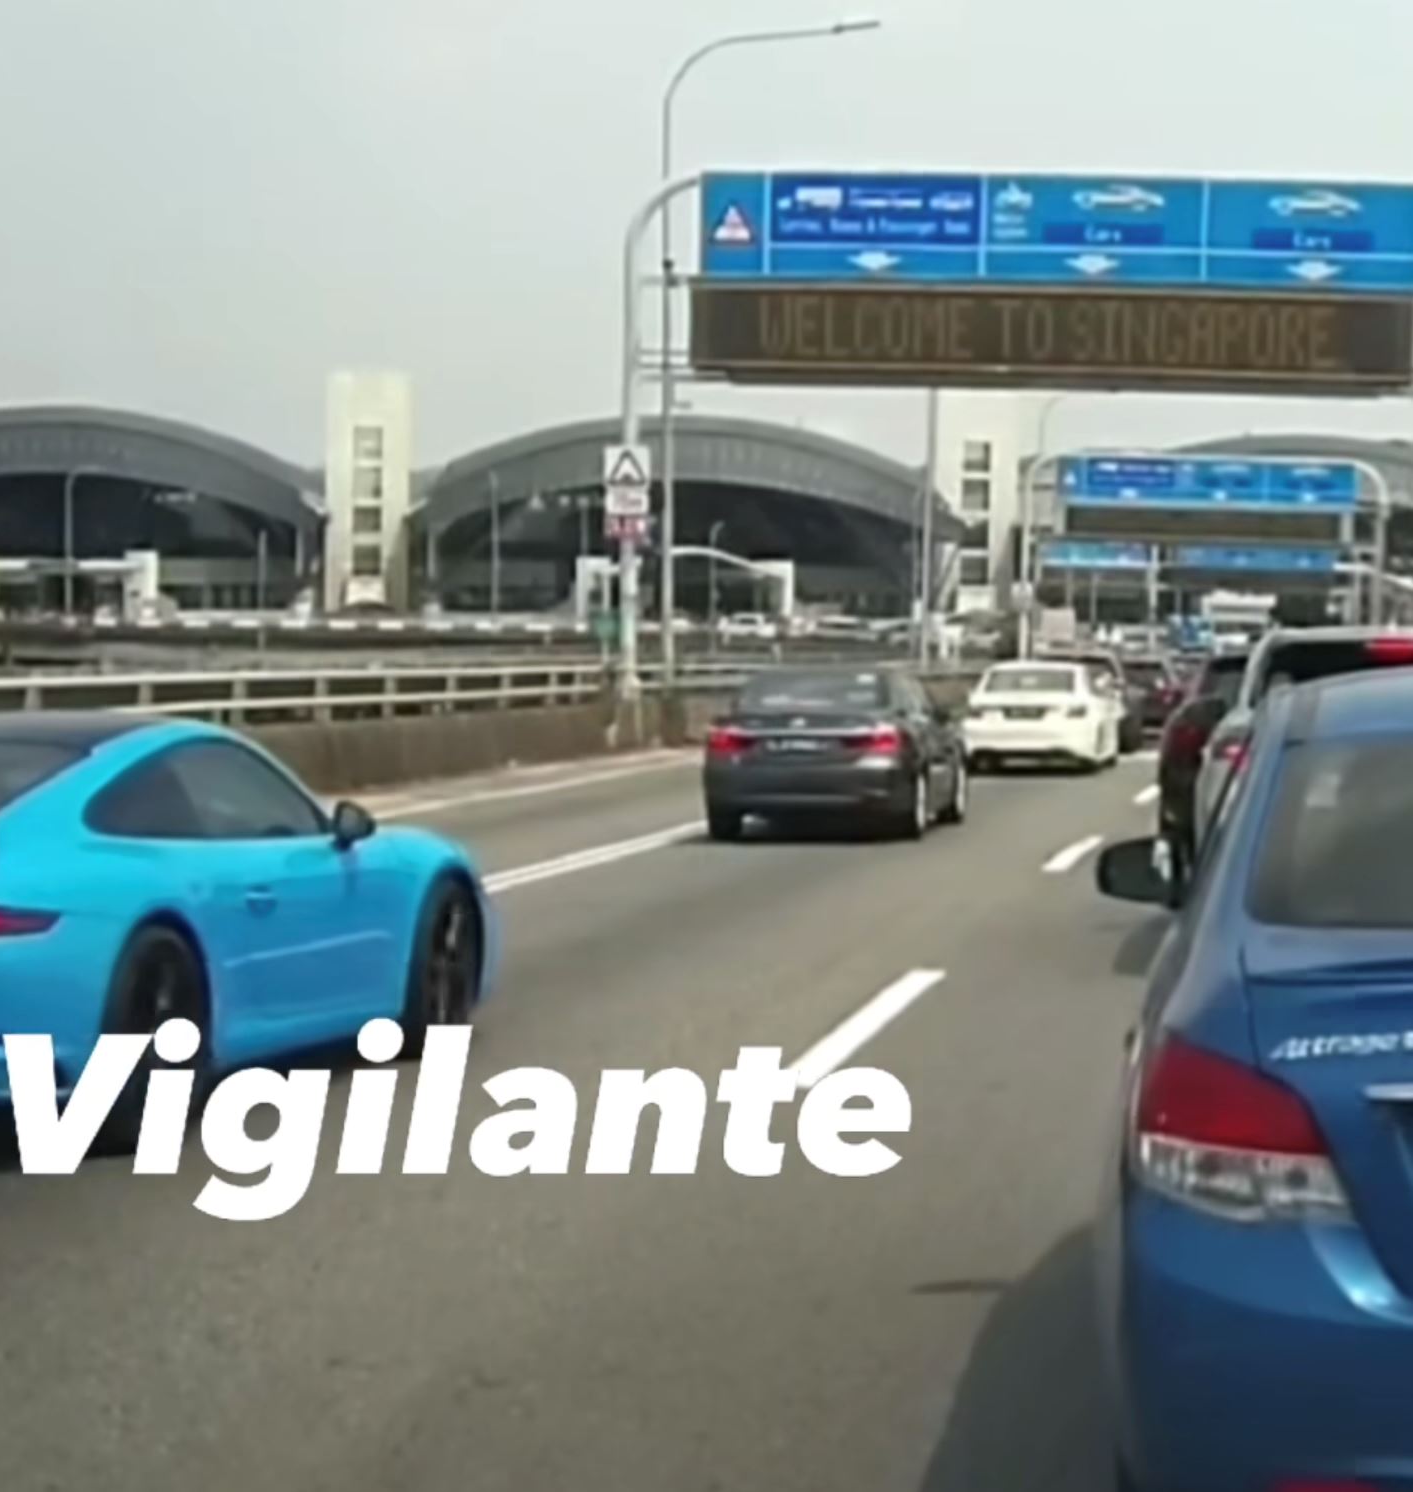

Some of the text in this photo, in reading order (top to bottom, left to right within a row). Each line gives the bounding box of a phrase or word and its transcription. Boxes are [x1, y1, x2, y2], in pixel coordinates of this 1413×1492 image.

[759, 295, 1337, 368] WELCOME TO SINGAPORE
